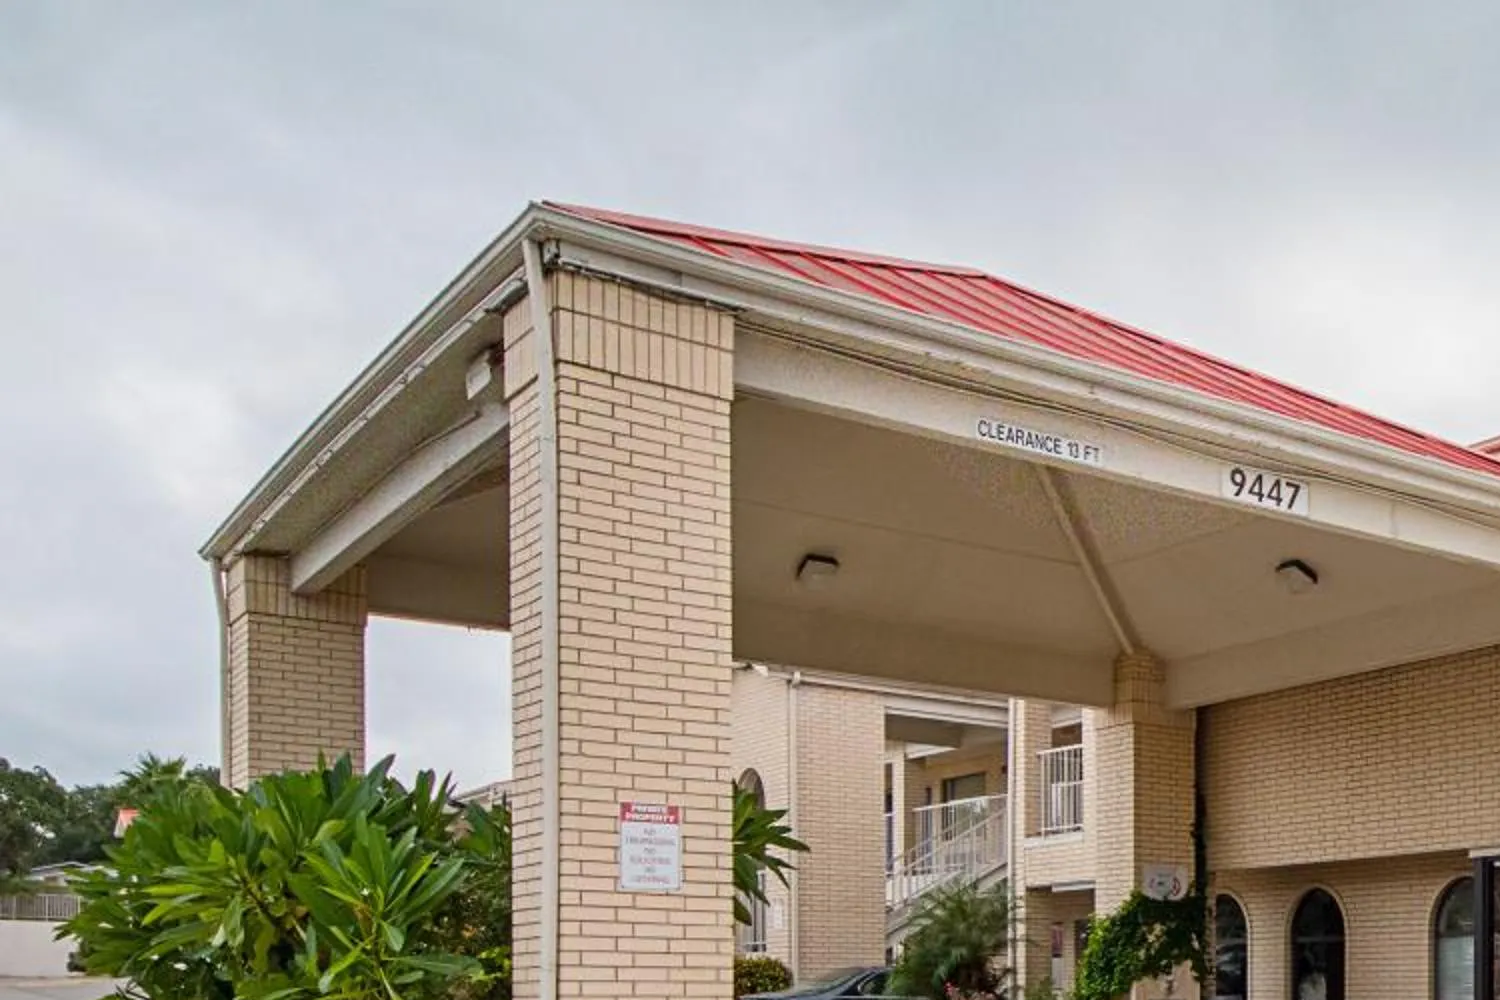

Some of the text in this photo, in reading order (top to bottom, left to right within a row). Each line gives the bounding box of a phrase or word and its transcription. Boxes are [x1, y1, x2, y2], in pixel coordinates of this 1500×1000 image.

[977, 419, 1100, 462] CLEARANCE 13 FT
[1230, 468, 1301, 509] 9447
